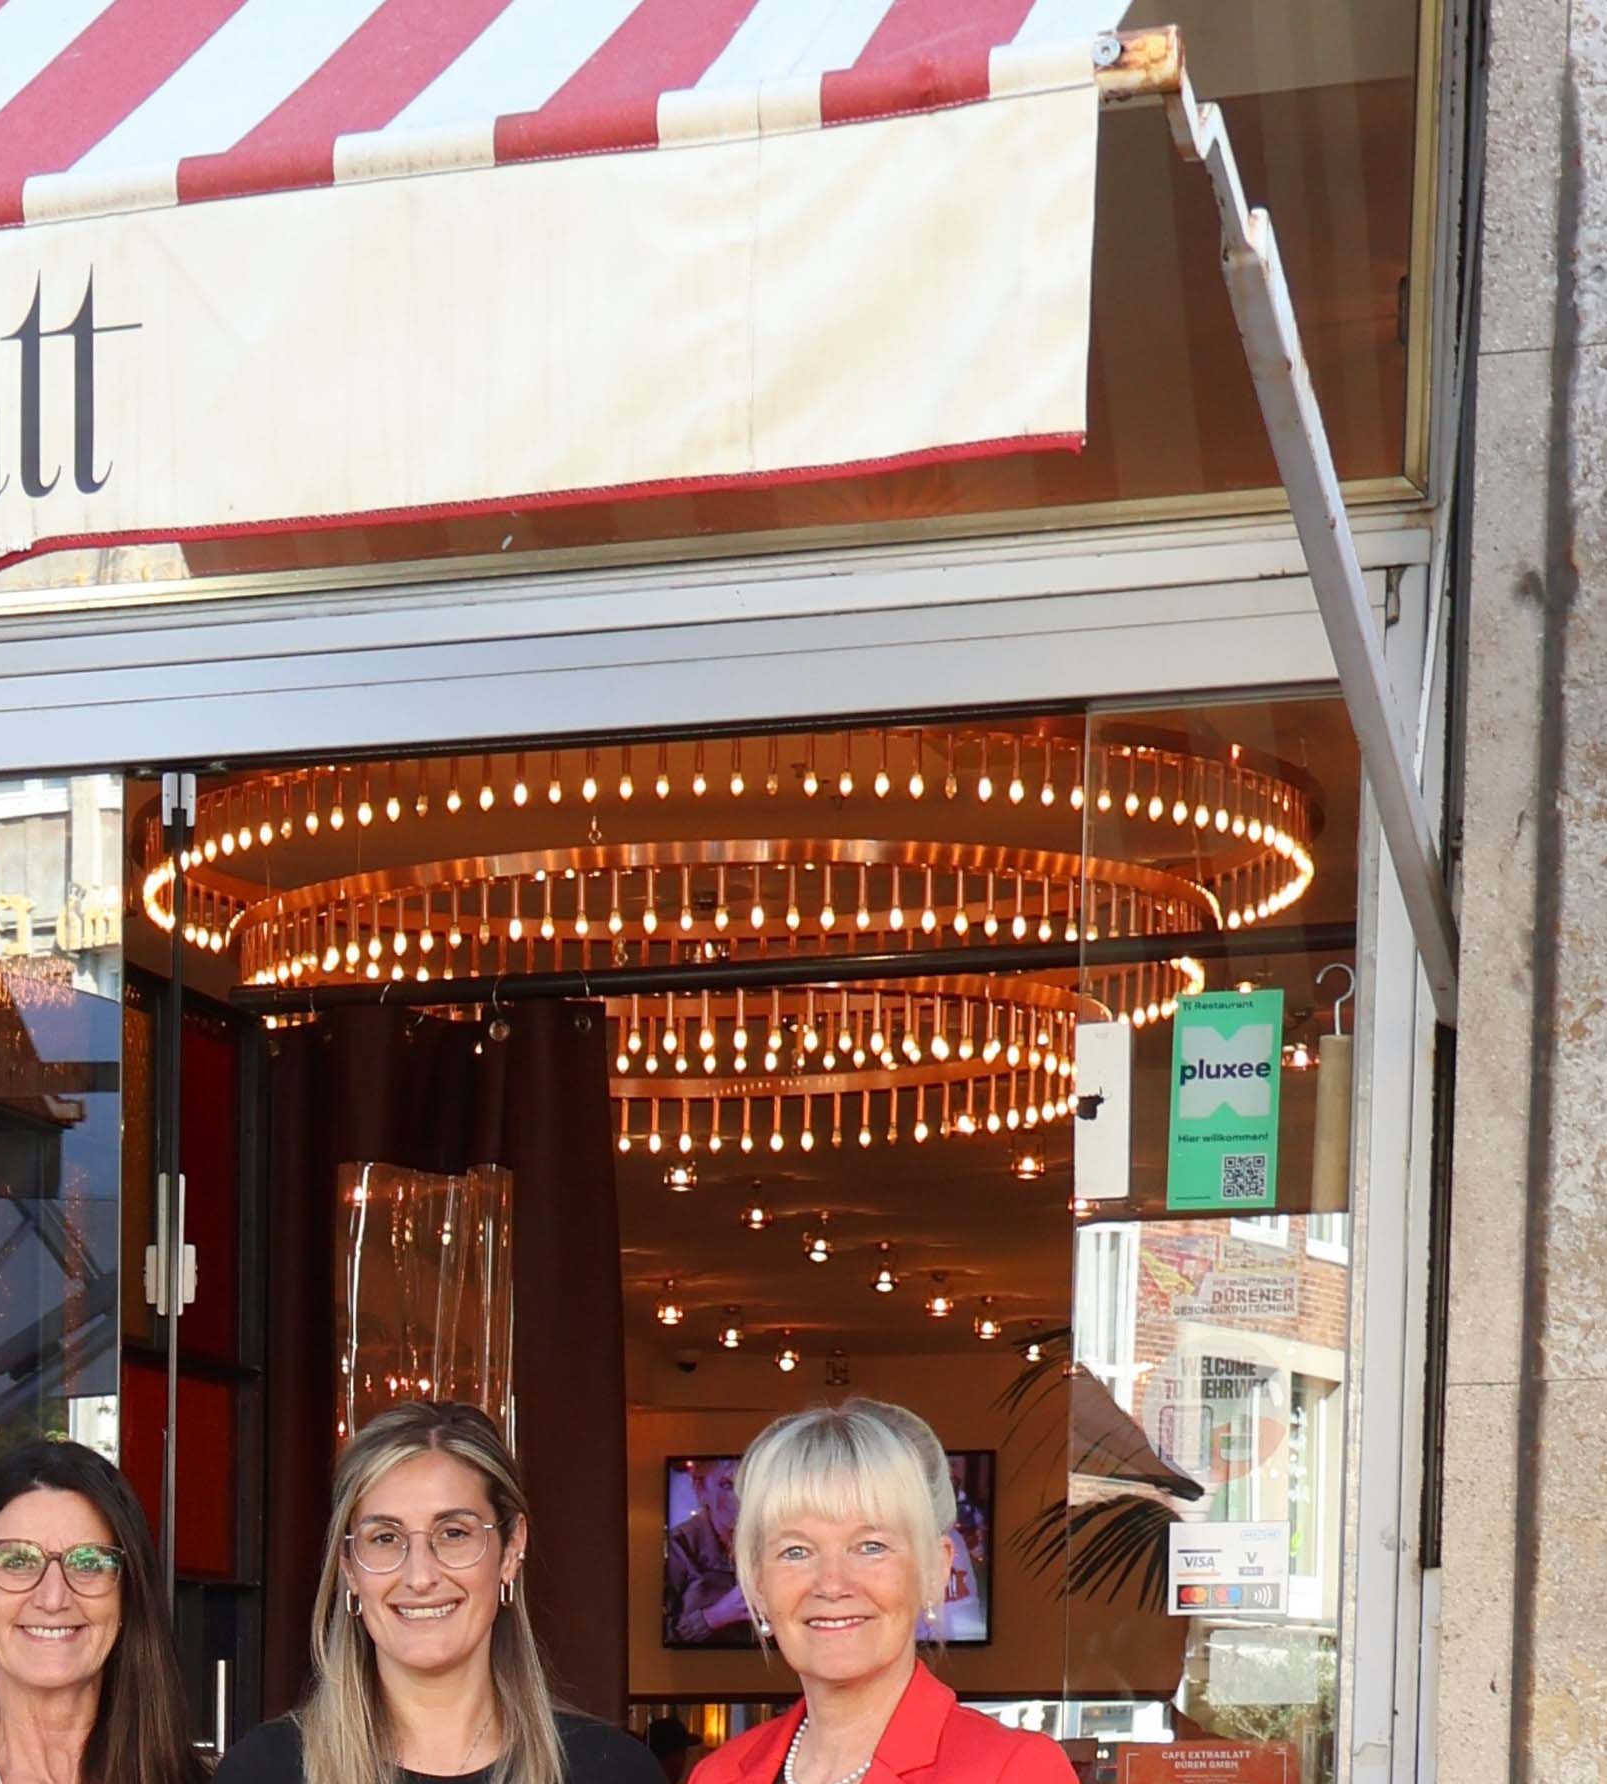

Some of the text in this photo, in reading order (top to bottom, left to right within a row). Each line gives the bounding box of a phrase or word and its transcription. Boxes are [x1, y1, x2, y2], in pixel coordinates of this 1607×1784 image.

[1194, 1001, 1254, 1010] Restaurant
[1180, 1059, 1271, 1086] pluxee
[1178, 1132, 1269, 1143] Hier willkommen!
[1212, 1287, 1295, 1304] DÜRENER
[1181, 1355, 1257, 1377] WELCOME
[1182, 1556, 1216, 1568] VISA
[1162, 1750, 1251, 1760] CAFE EXTRABLATT
[1174, 1760, 1207, 1769] DÜREN
